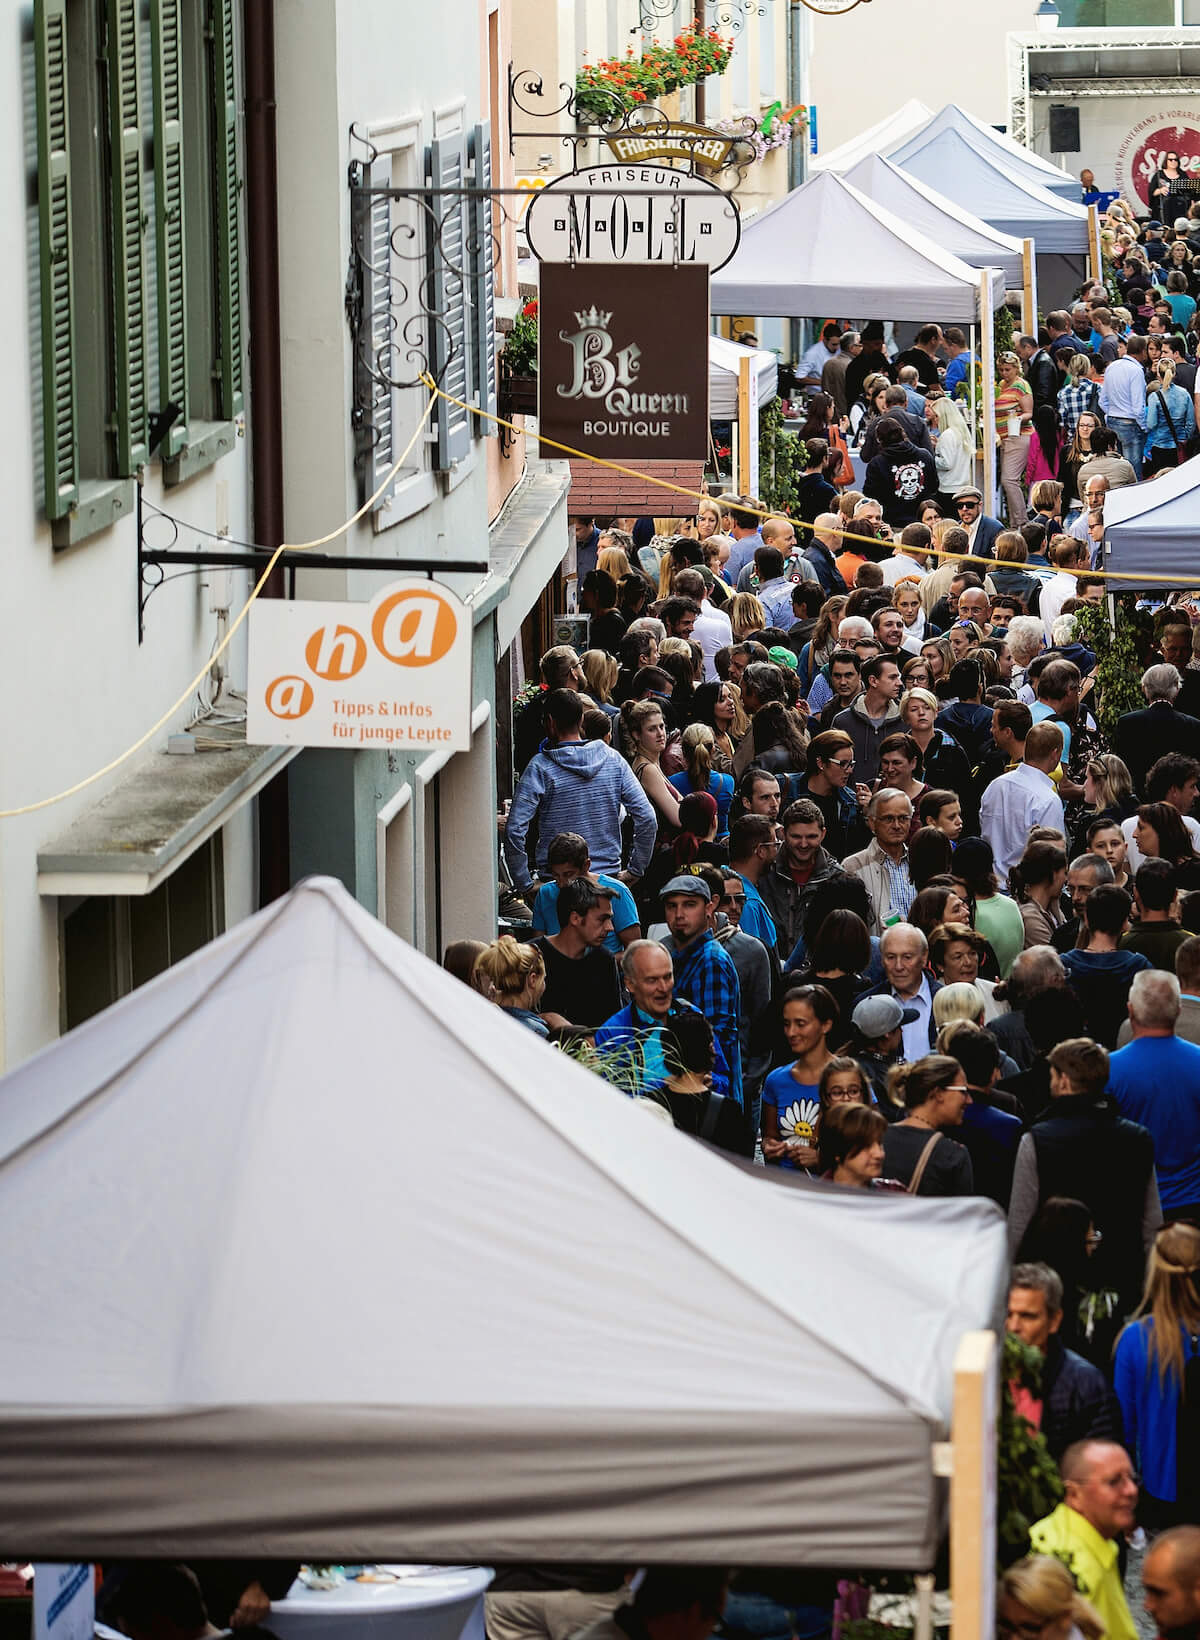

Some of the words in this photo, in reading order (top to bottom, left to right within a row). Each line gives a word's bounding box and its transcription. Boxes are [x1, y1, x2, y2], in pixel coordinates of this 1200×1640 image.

[588, 169, 681, 188] FRISEUR
[568, 194, 696, 260] MOLL
[557, 328, 641, 400] Be
[605, 387, 688, 417] Queen
[584, 420, 670, 436] BOUTIQUE
[332, 699, 374, 718] Tipps
[378, 701, 389, 716] &
[393, 701, 433, 717] Infos
[332, 722, 355, 738] für
[359, 724, 403, 742] junge
